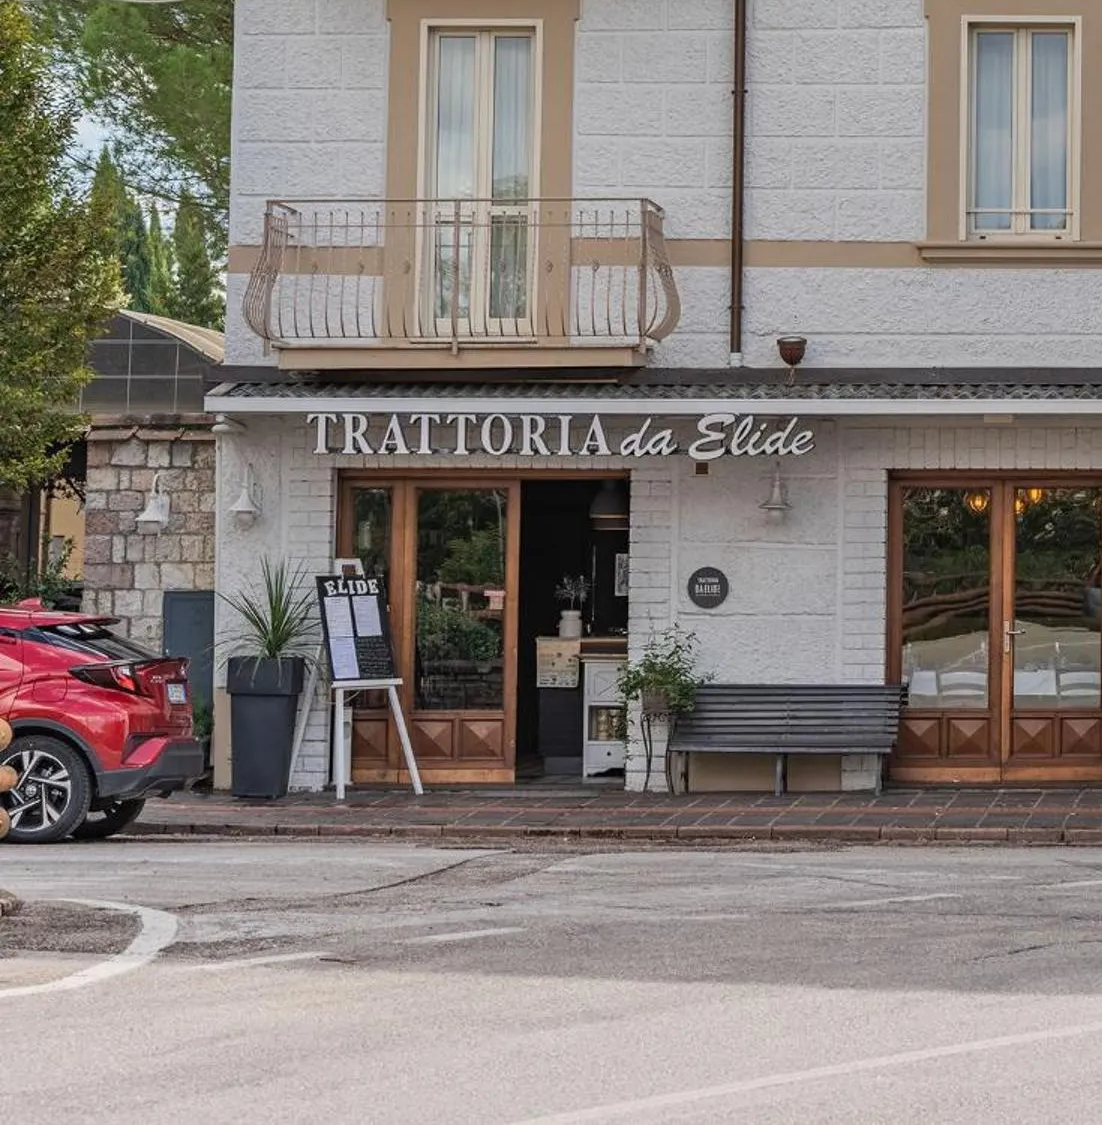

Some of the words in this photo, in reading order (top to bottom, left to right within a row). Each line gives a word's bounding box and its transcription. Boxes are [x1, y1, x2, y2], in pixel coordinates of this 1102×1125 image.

[306, 413, 612, 456] TRATTORIA
[619, 417, 679, 457] da
[688, 412, 816, 461] Elide
[324, 579, 379, 596] ELIDE
